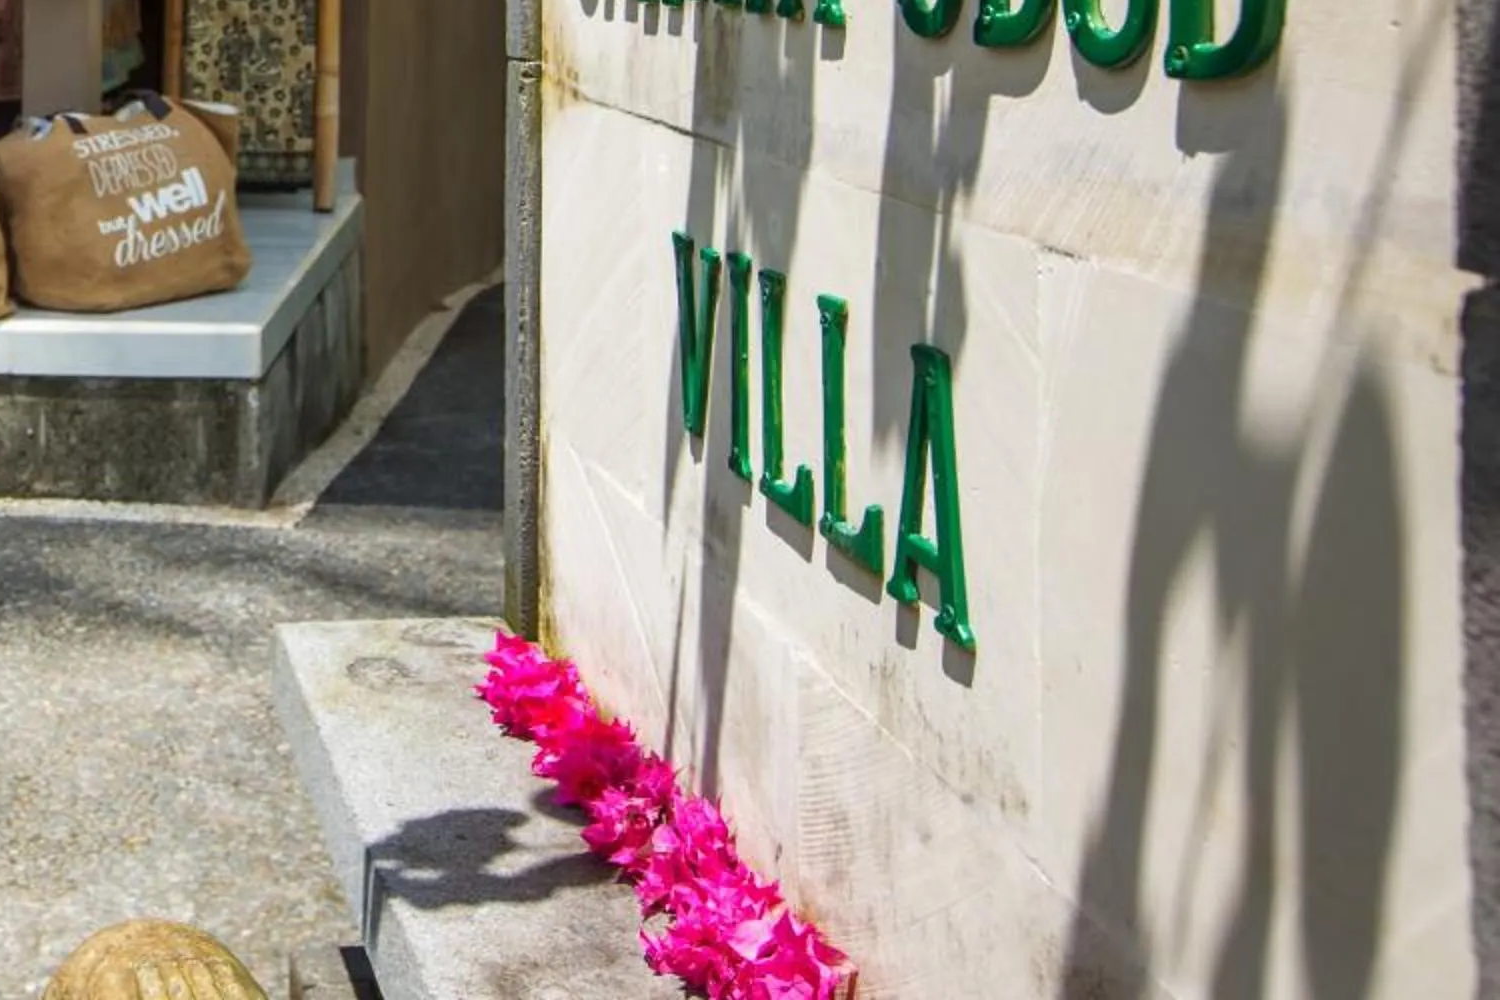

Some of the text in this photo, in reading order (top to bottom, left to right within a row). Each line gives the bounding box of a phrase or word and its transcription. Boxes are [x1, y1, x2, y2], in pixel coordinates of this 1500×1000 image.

[87, 144, 178, 199] DEPRESSED
[126, 166, 209, 224] well
[114, 188, 227, 269] dressed
[672, 231, 976, 652] VILLA
